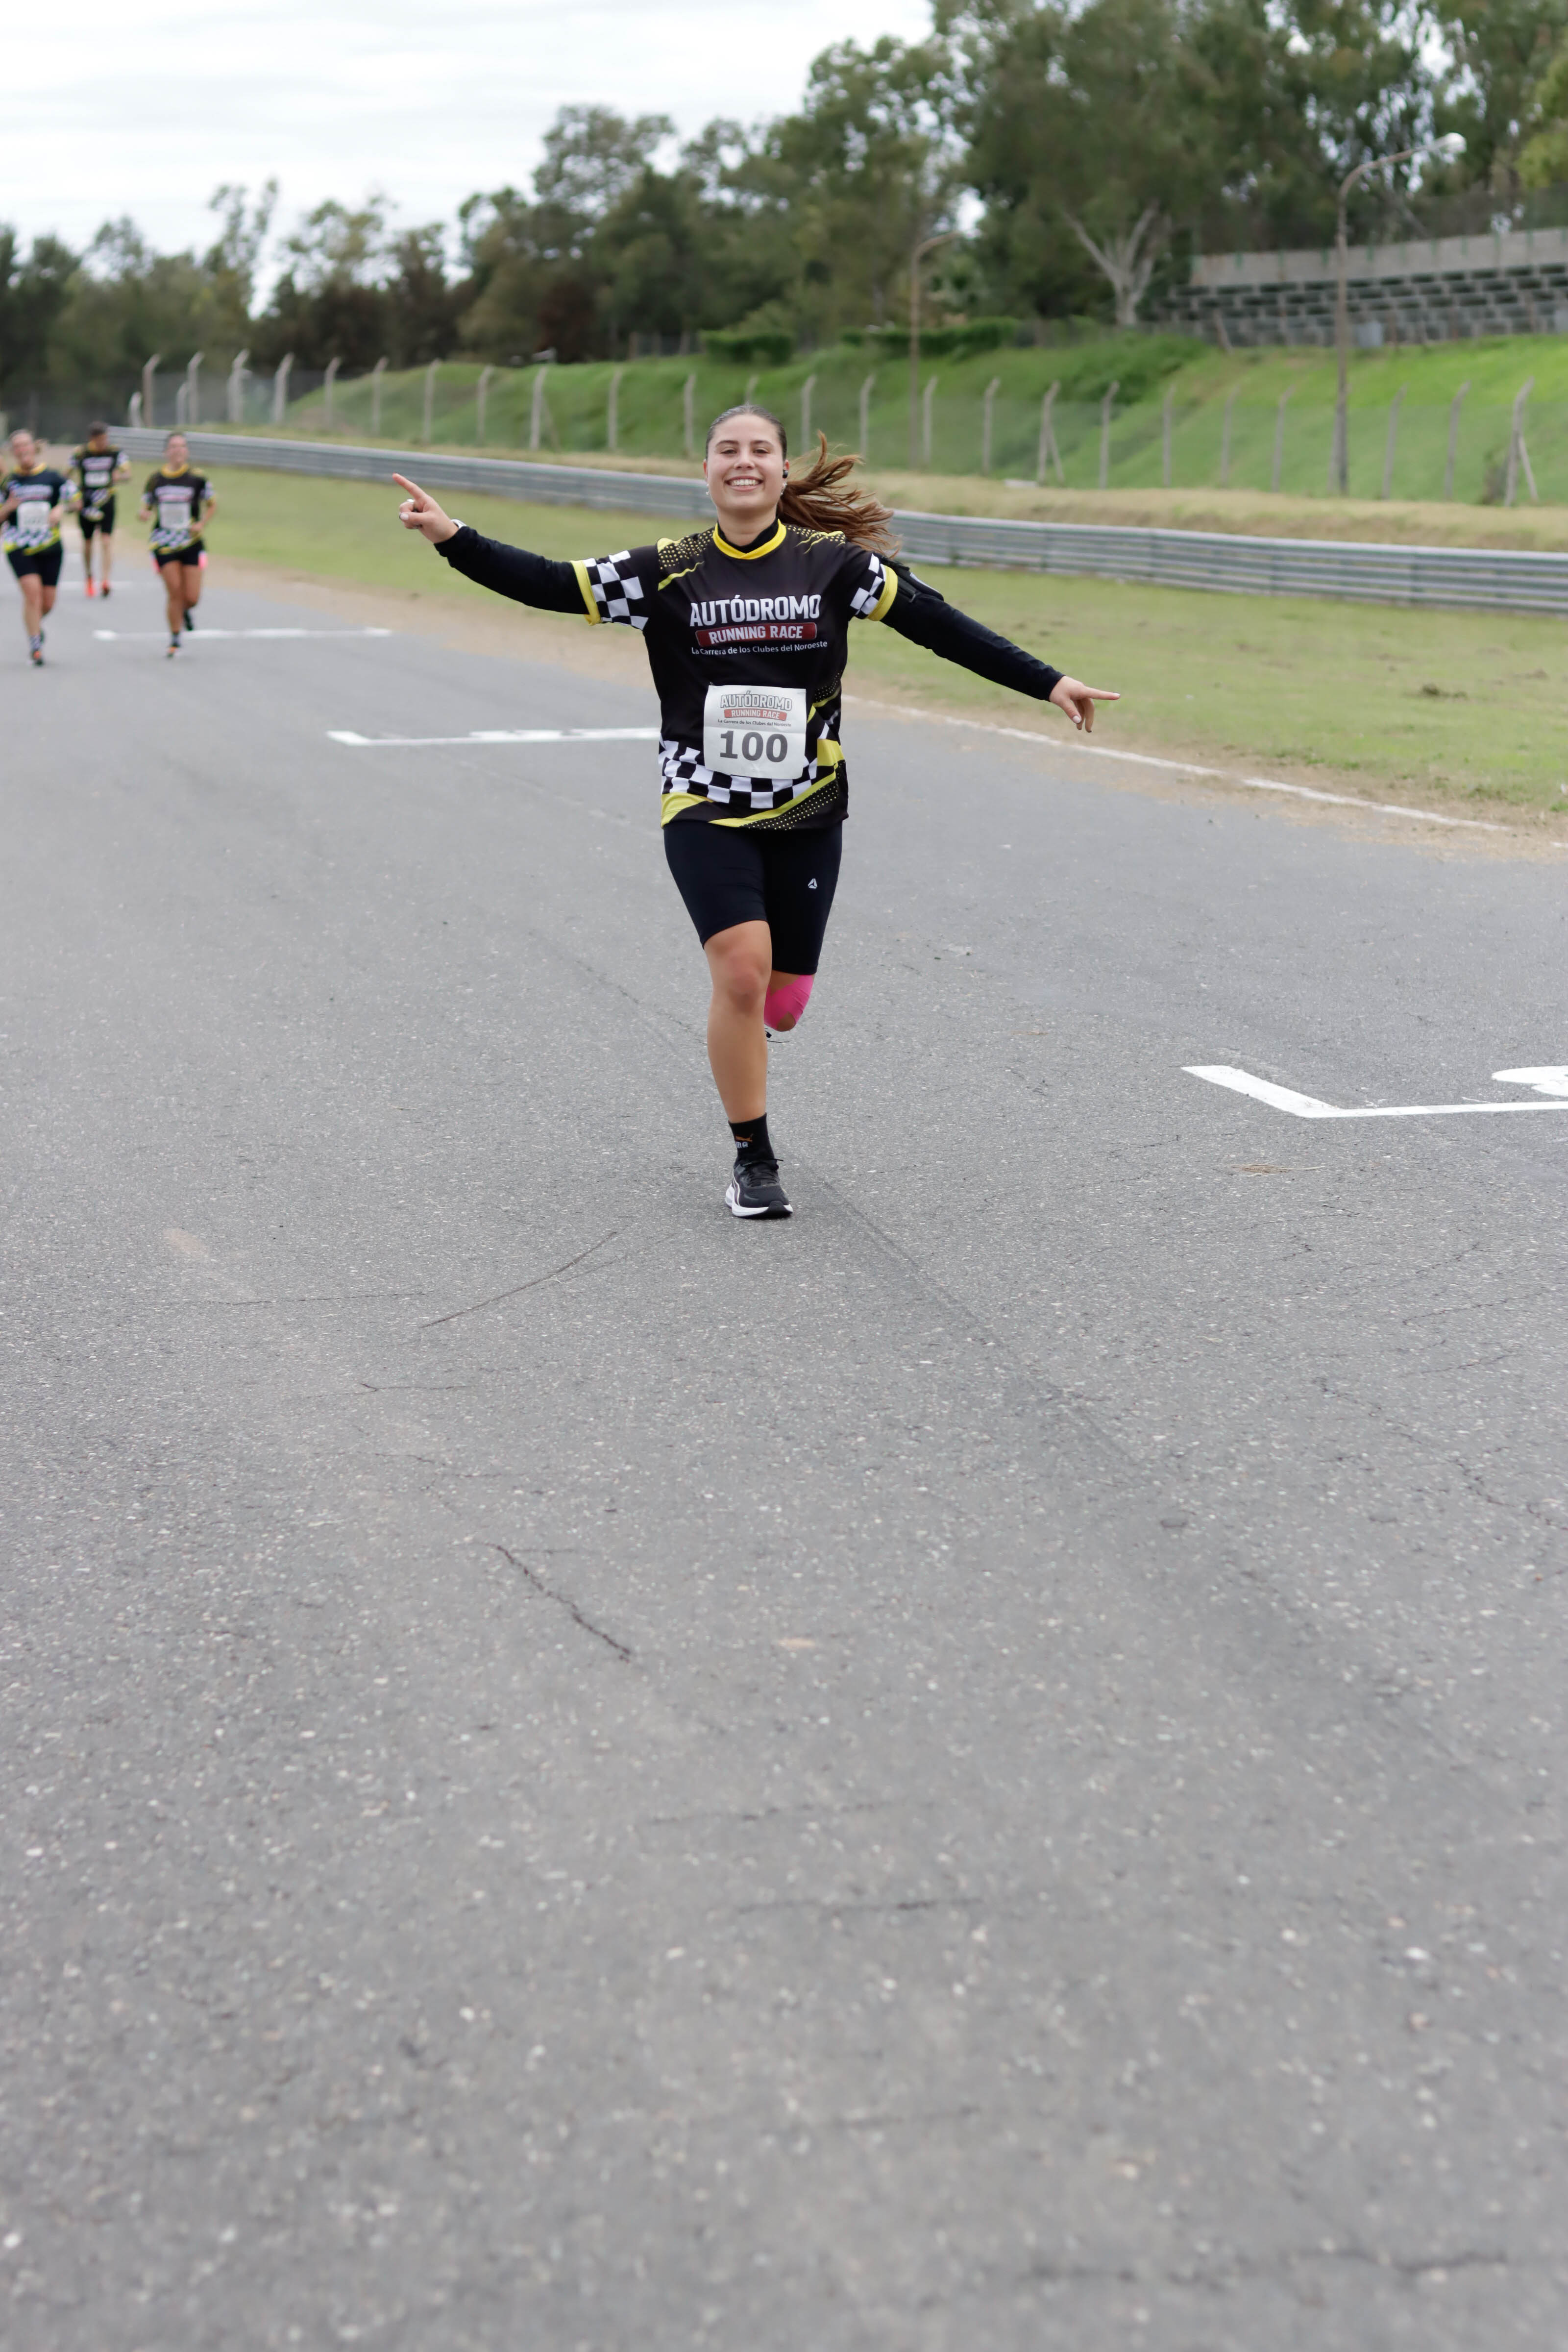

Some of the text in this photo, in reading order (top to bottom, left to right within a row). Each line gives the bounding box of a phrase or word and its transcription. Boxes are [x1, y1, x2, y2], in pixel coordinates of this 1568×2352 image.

[689, 594, 822, 627] AUTÓDROMO
[709, 625, 804, 644] RUNNING RACE
[794, 640, 828, 651] Noroeste
[720, 690, 792, 711] AUTÓDROMO
[731, 709, 781, 719] RUNNING RACE
[720, 731, 788, 762] 100
